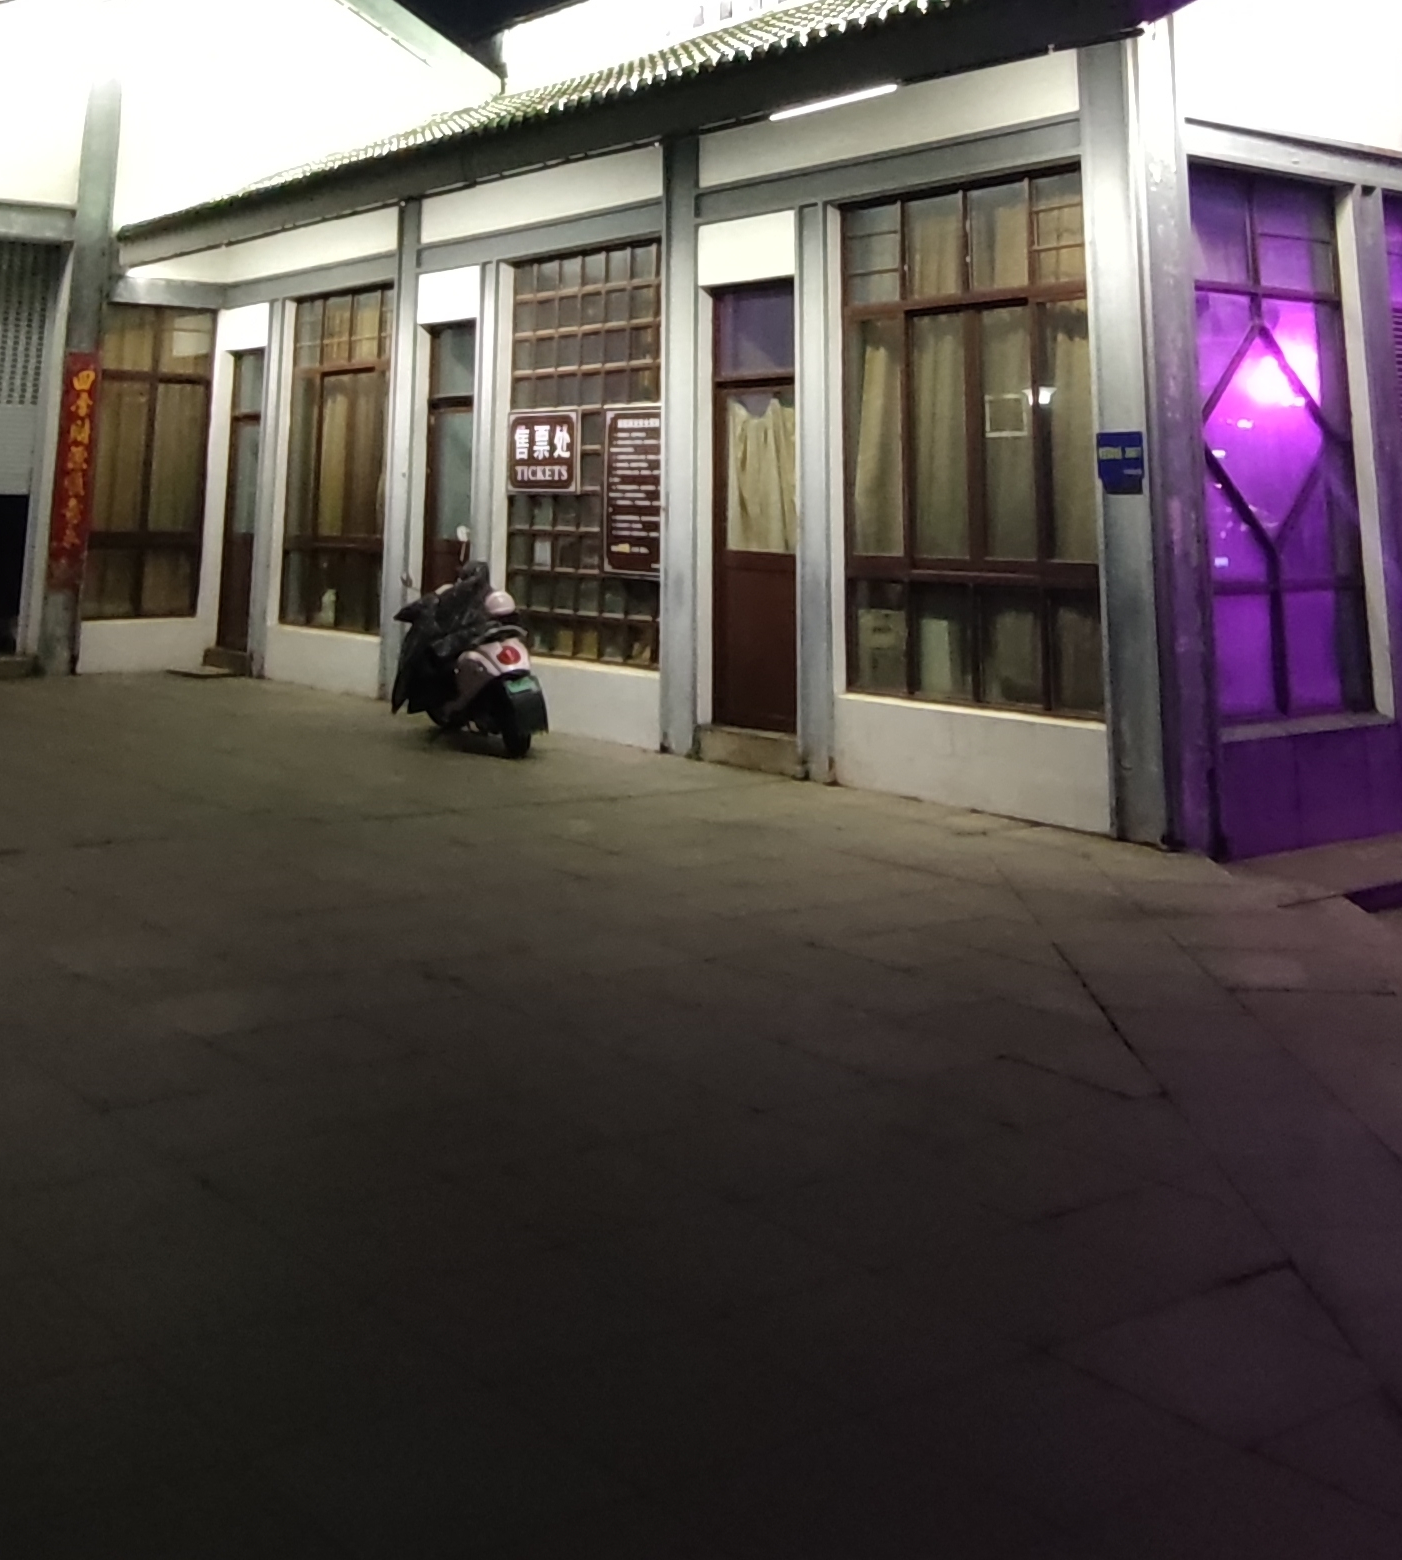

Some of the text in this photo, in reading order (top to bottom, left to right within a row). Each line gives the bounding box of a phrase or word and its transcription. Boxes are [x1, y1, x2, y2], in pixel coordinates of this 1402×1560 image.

[514, 424, 571, 460] 售票处
[514, 465, 568, 481] TICKETS
